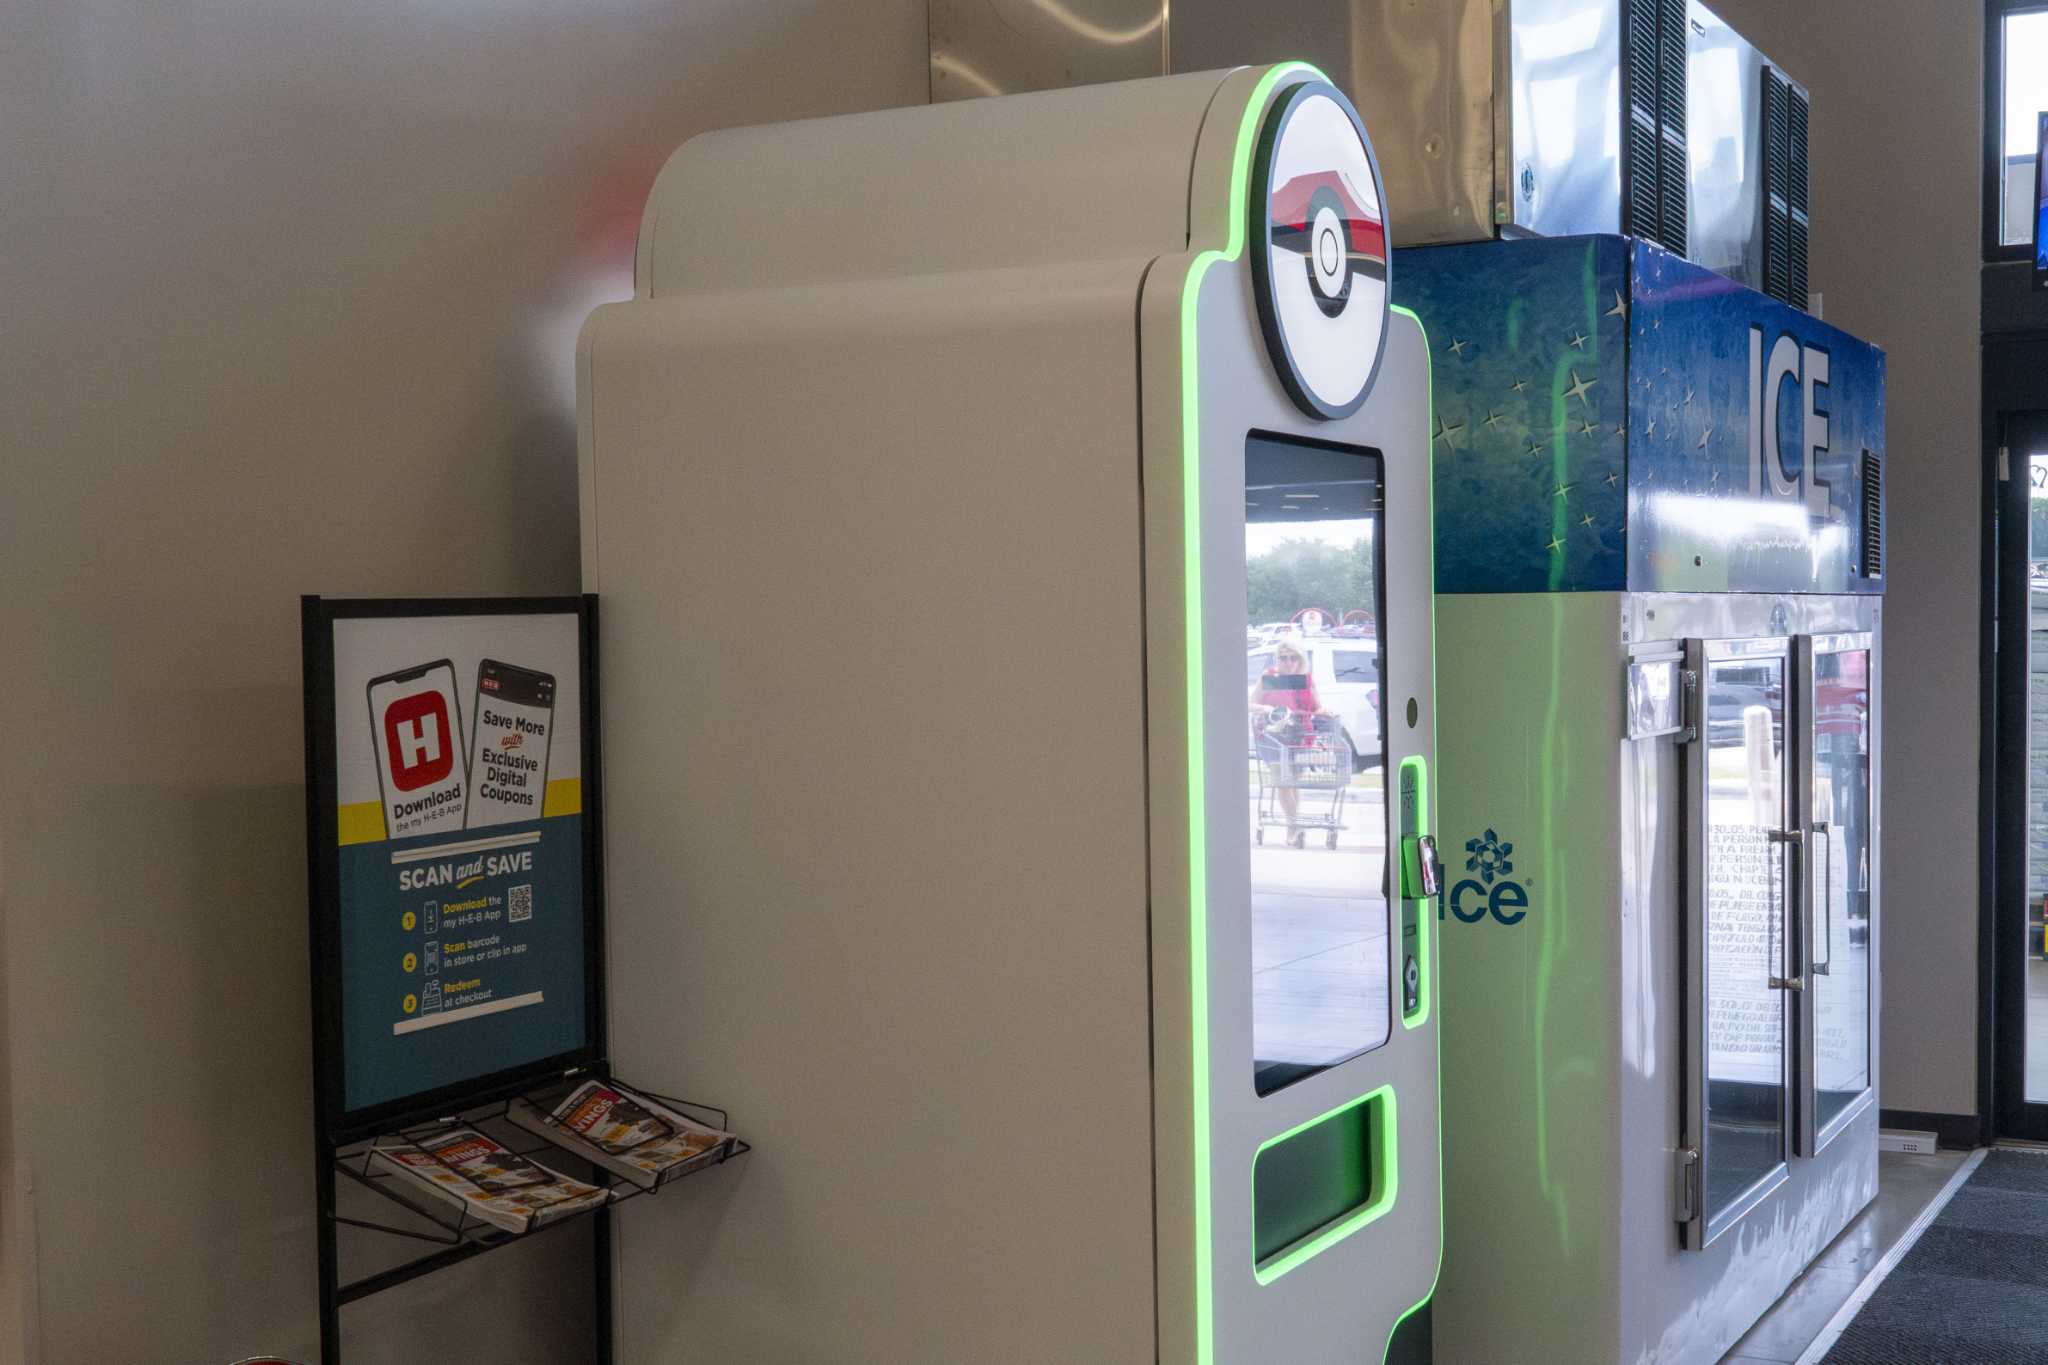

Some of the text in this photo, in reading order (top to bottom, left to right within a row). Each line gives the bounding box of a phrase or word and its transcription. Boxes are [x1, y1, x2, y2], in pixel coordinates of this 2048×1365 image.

[1748, 324, 1830, 519] ICE
[483, 710, 545, 736] Save More
[397, 712, 441, 770] H
[501, 734, 523, 746] with
[482, 748, 538, 772] Exclusive
[487, 767, 527, 787] Digital
[394, 783, 461, 819] Download
[480, 784, 533, 806] Coupons
[447, 804, 462, 815] App
[400, 852, 532, 890] SCAN and SAVE
[443, 896, 502, 914] Download the
[443, 918, 457, 928] my
[484, 910, 501, 921] App
[443, 934, 500, 954] Scan barcode
[454, 954, 475, 966] store
[476, 951, 486, 961] or
[487, 947, 502, 960] clip
[503, 945, 511, 955] in
[512, 944, 528, 954] app
[455, 989, 493, 1007] checkout
